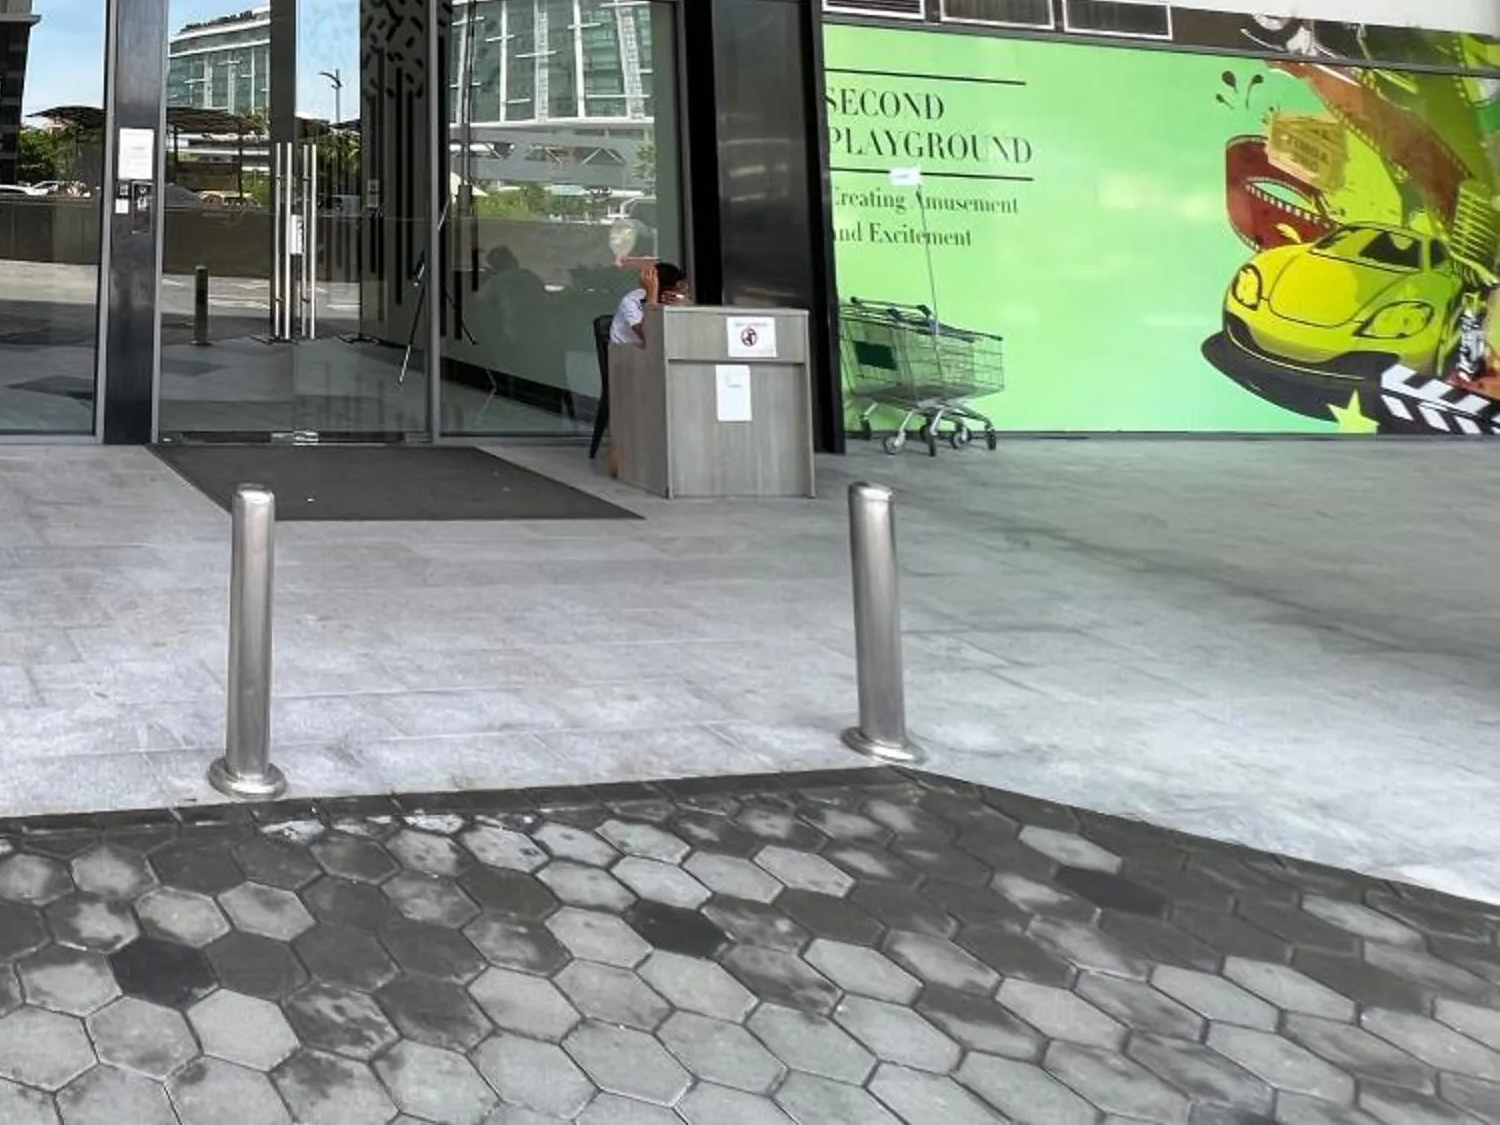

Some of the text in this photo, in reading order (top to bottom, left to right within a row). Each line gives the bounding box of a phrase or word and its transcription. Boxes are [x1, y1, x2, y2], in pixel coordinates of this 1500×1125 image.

[825, 87, 945, 120] SECOND
[829, 127, 1033, 164] PLAYGROUND
[834, 186, 905, 214] reating
[869, 222, 972, 246] Excitement
